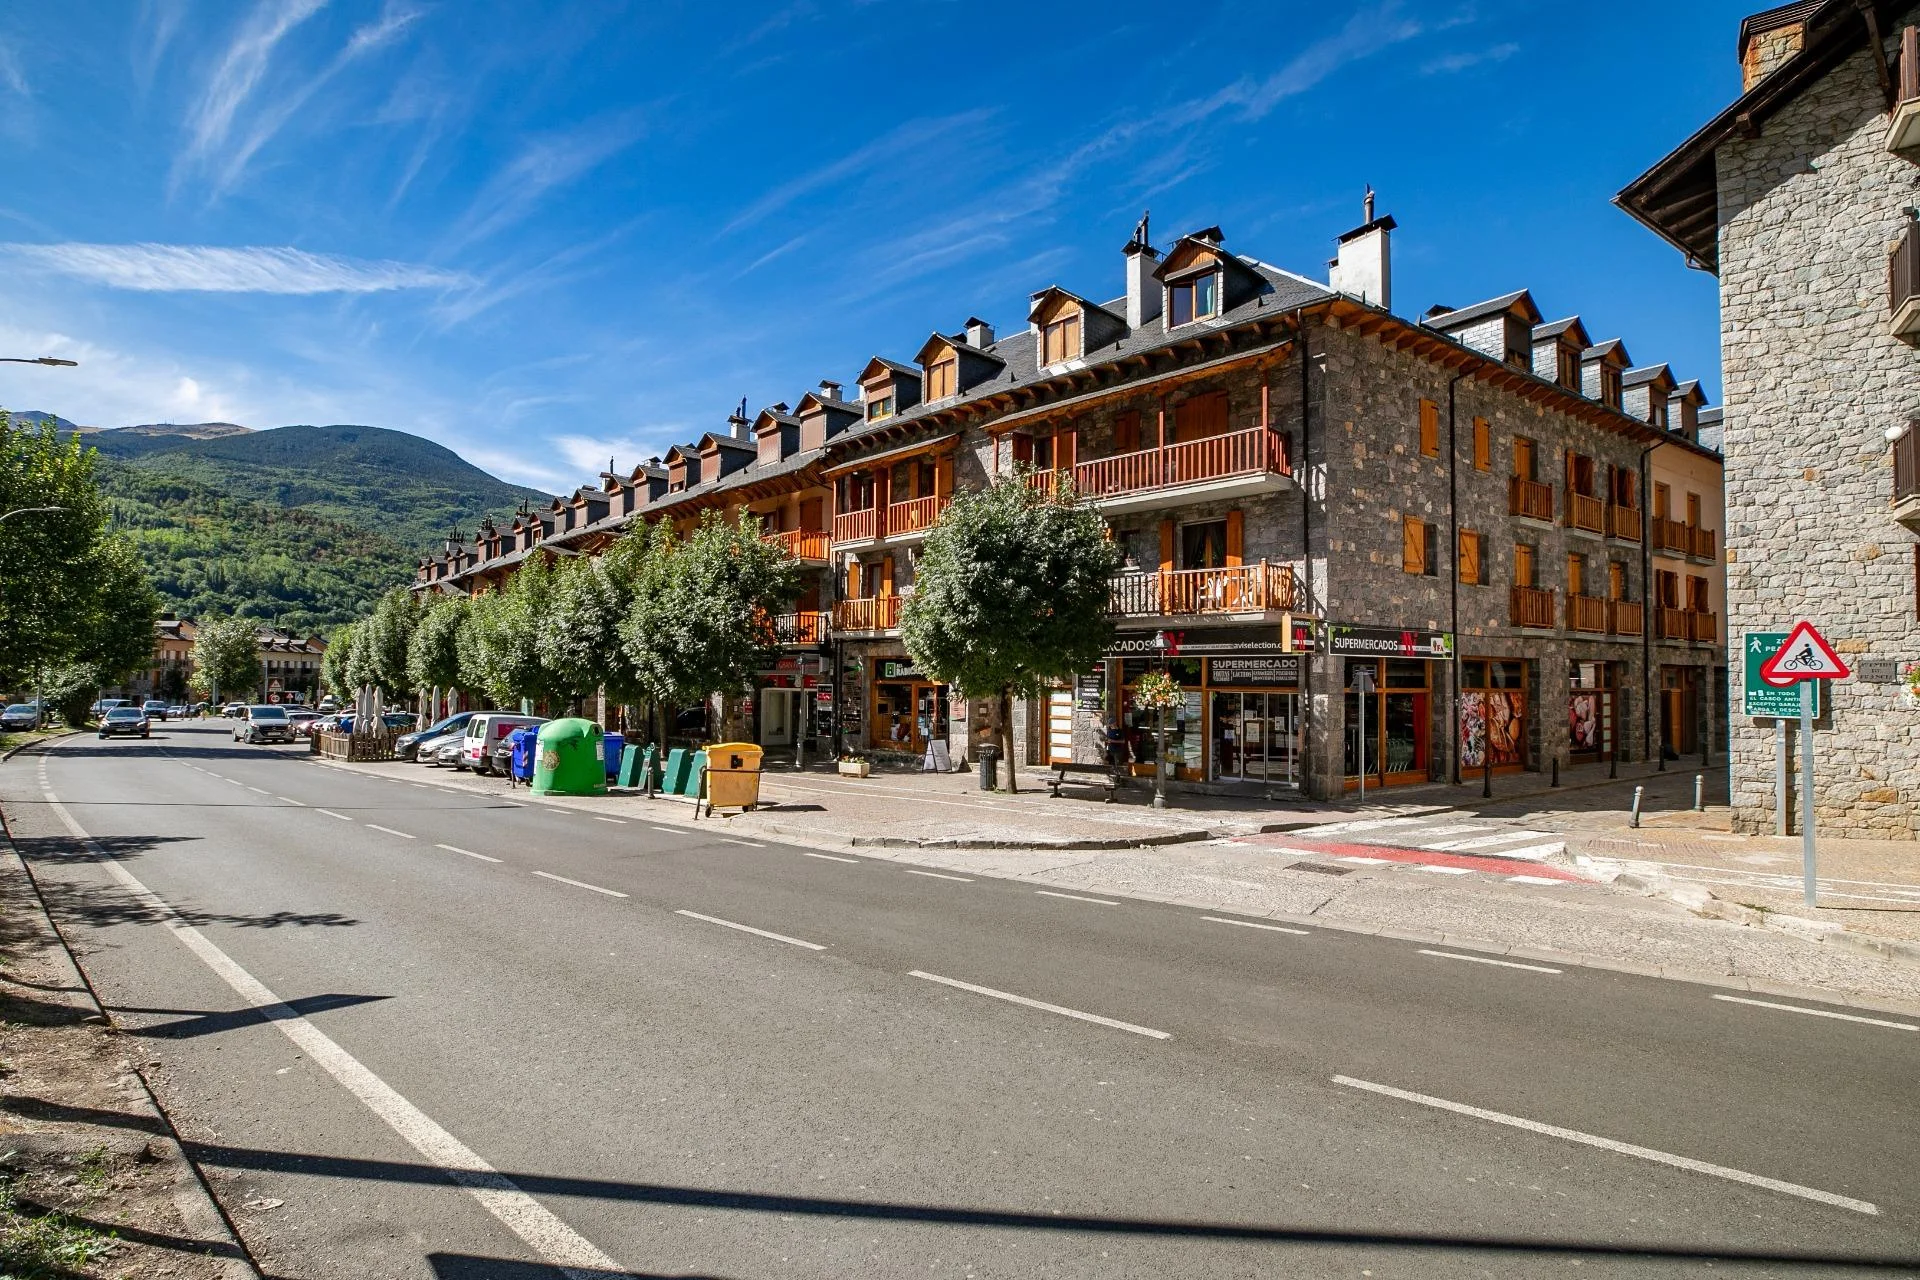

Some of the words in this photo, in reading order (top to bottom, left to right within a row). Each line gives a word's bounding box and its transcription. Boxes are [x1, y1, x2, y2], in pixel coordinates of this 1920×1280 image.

[1233, 641, 1283, 649] aviselection.c
[1334, 637, 1398, 651] SUPERMERCADOS
[1212, 659, 1298, 669] SUPERMERCADO
